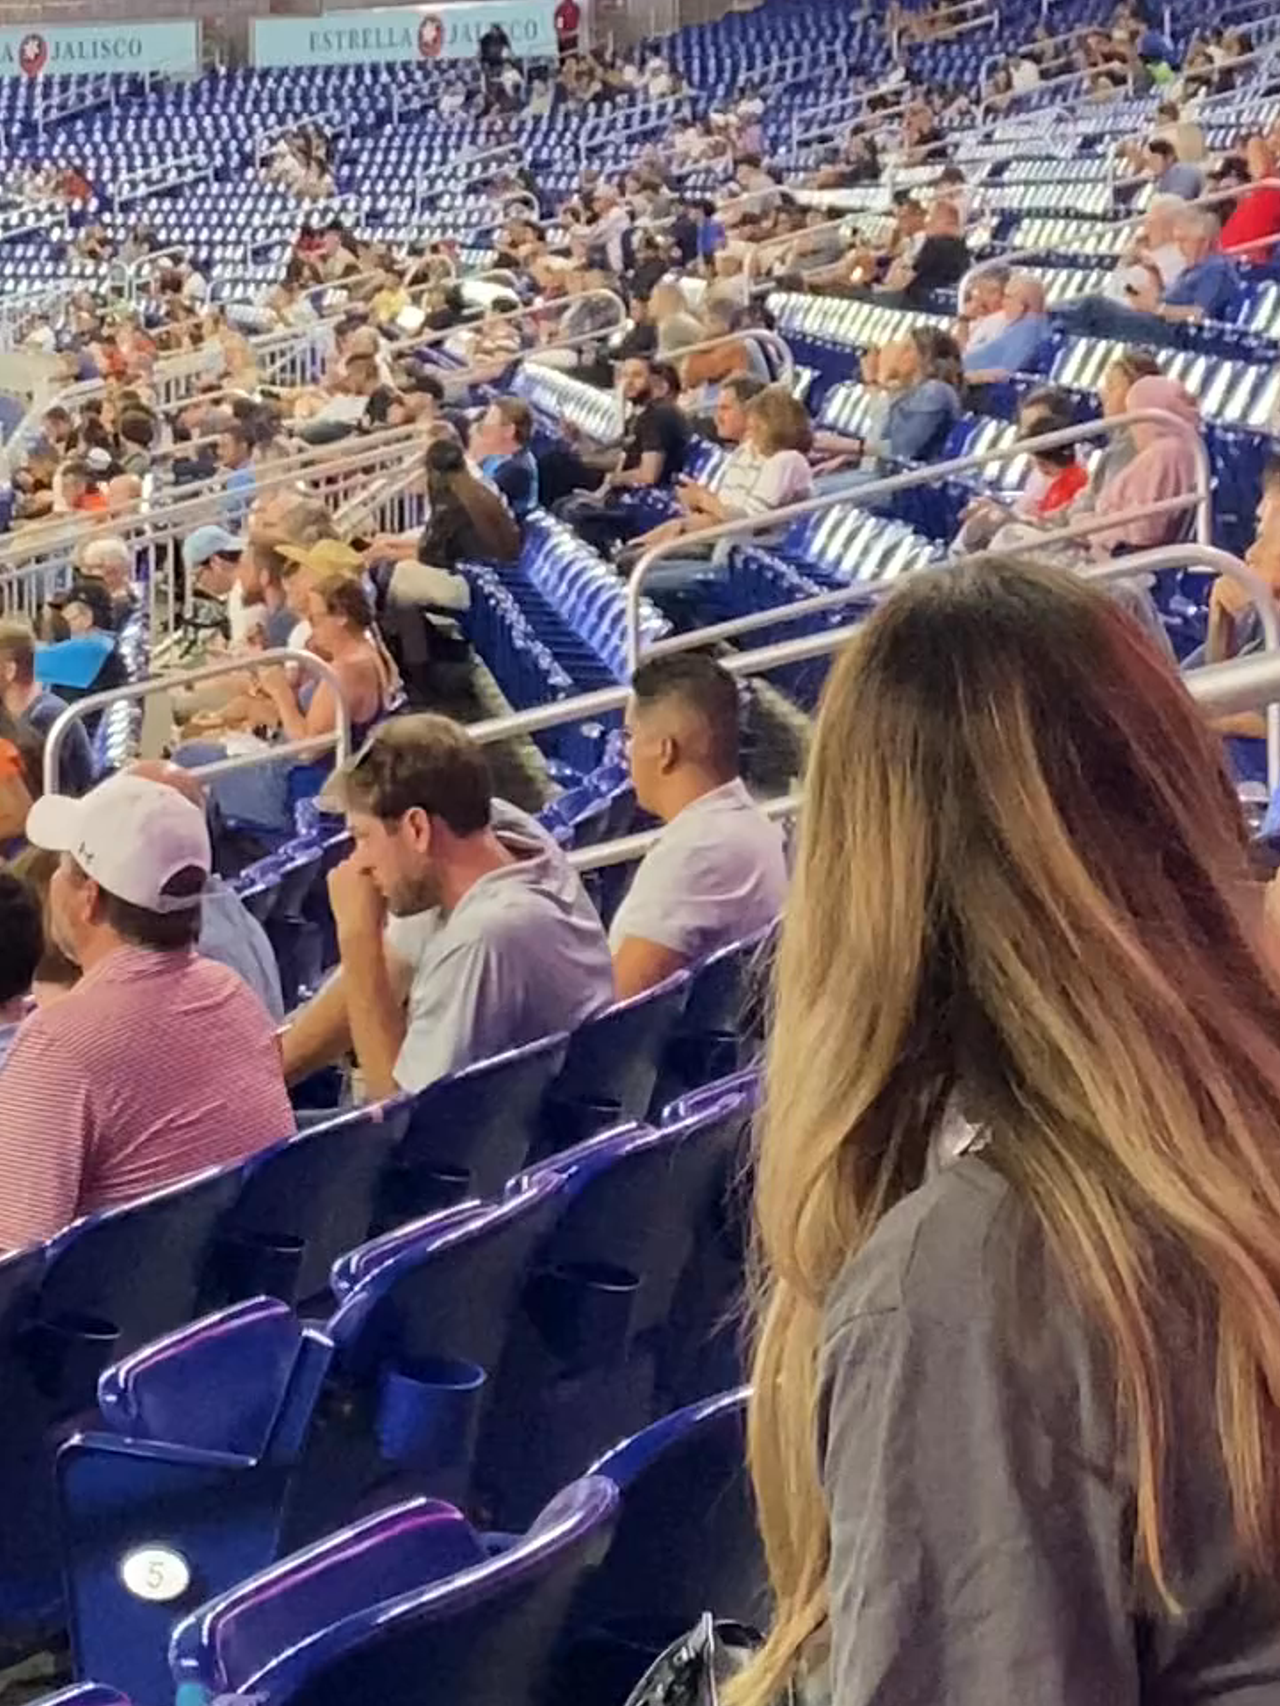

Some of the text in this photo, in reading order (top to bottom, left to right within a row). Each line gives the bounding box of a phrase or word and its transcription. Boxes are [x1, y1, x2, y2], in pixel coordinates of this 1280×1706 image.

[50, 38, 143, 61] JALISCO
[309, 18, 538, 53] ESTRELLA JALCO
[147, 1560, 164, 1589] 5
